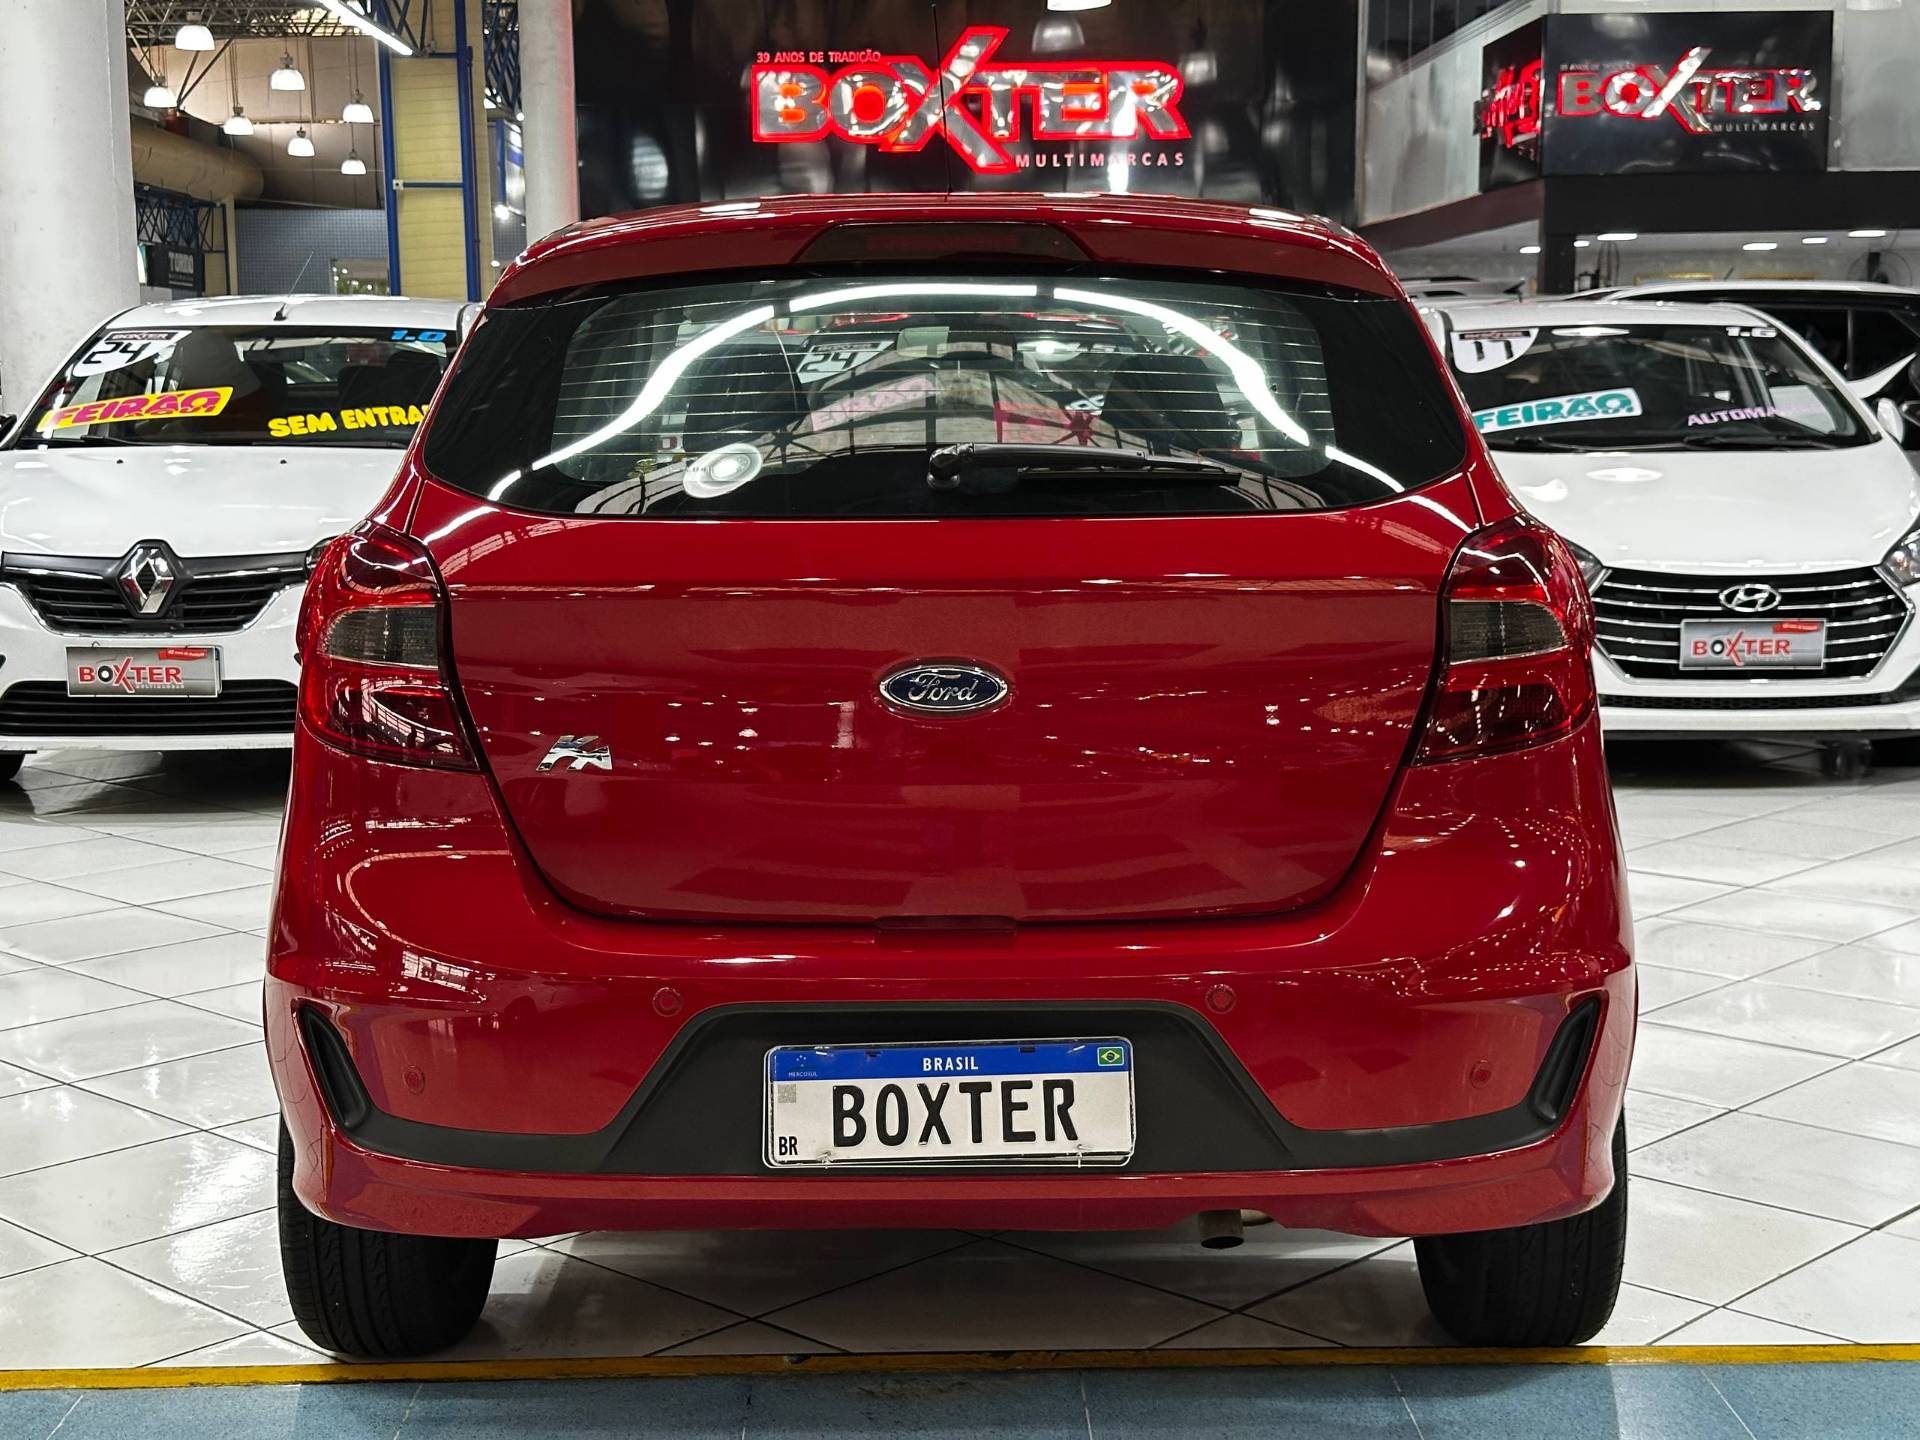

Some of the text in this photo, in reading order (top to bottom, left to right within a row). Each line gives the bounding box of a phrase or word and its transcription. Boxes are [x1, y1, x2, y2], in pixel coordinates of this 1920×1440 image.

[756, 48, 881, 64] 39 ANOS DE TRADIÇÃO
[751, 25, 1192, 174] BOXTER
[1558, 47, 1821, 134] BOXTER
[1713, 121, 1815, 133] MULTIMARCAS
[1015, 152, 1184, 168] MULTIMARCAS
[391, 330, 447, 341] 1.0
[82, 341, 152, 364] 24
[800, 352, 858, 372] 24
[50, 391, 221, 426] FEIRÃO
[1473, 393, 1634, 429] FEIRÃO
[268, 412, 337, 437] SEM
[1692, 630, 1791, 667] BOXTER
[78, 657, 183, 693] BOXTER
[908, 672, 979, 701] Ford
[923, 1056, 978, 1071] BRASIL
[832, 1078, 1079, 1148] BOXTER
[778, 1135, 799, 1157] BR
